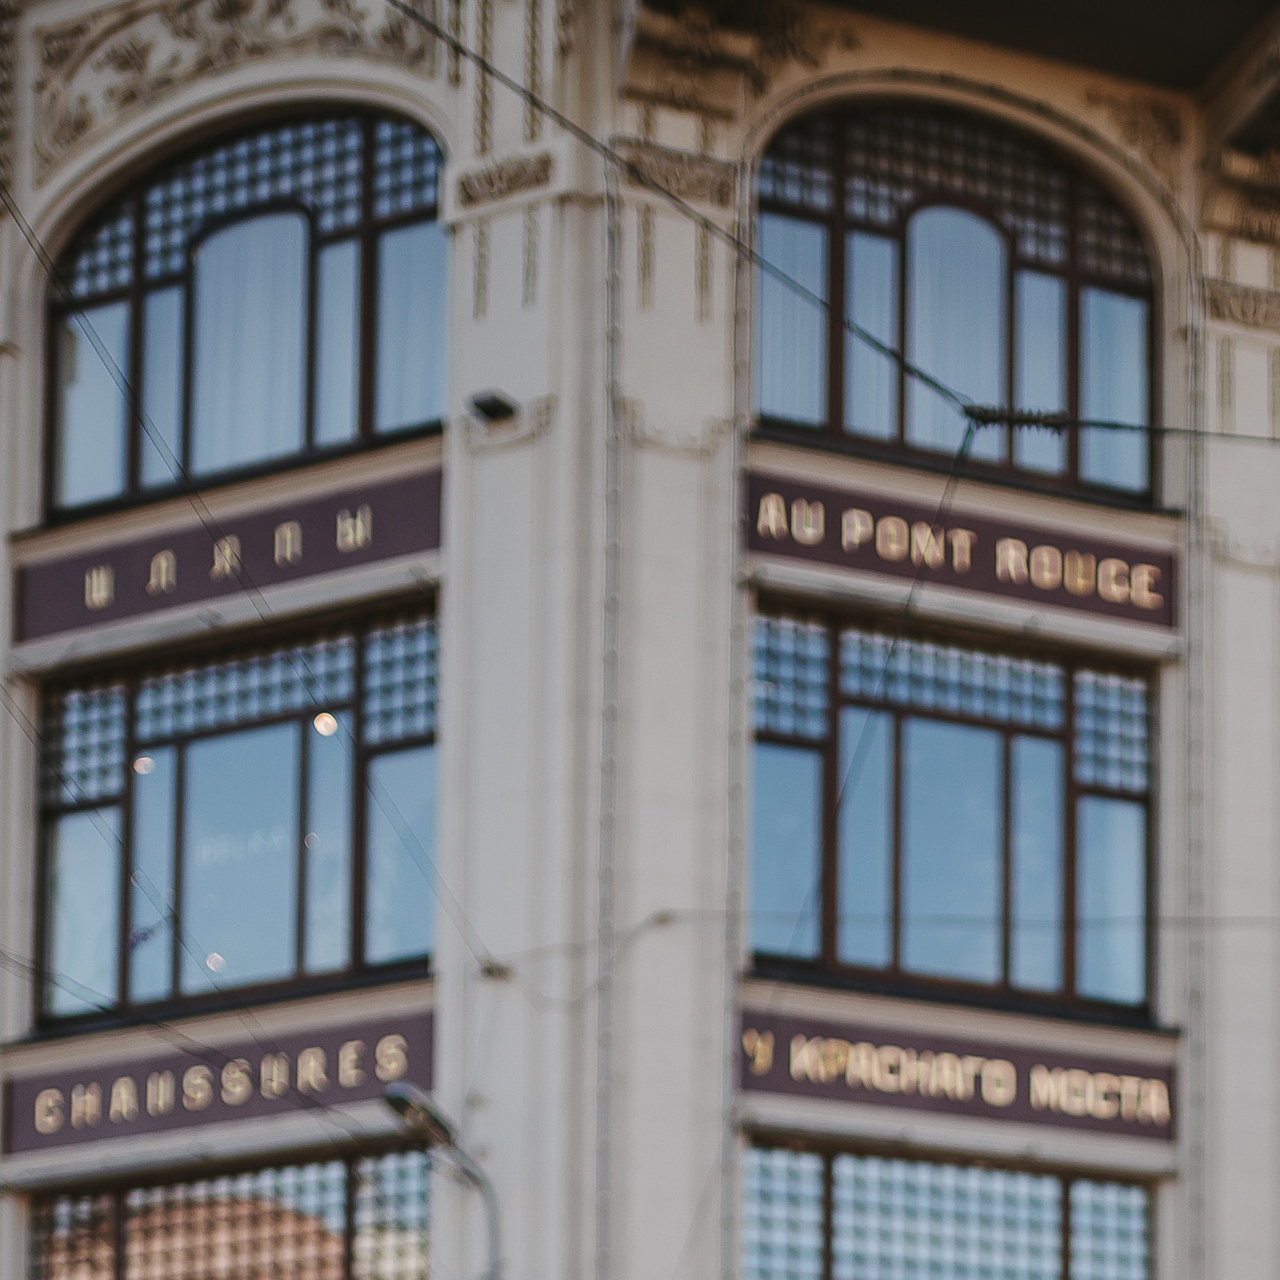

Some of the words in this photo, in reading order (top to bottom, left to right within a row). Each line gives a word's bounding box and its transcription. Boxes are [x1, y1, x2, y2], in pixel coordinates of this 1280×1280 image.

[756, 492, 826, 546] AU
[840, 507, 978, 574] PONT
[995, 536, 1165, 610] ROUGE
[34, 1033, 409, 1135] CHAUSSURES
[741, 1027, 775, 1076] У
[1029, 1063, 1171, 1127] МОСТА
